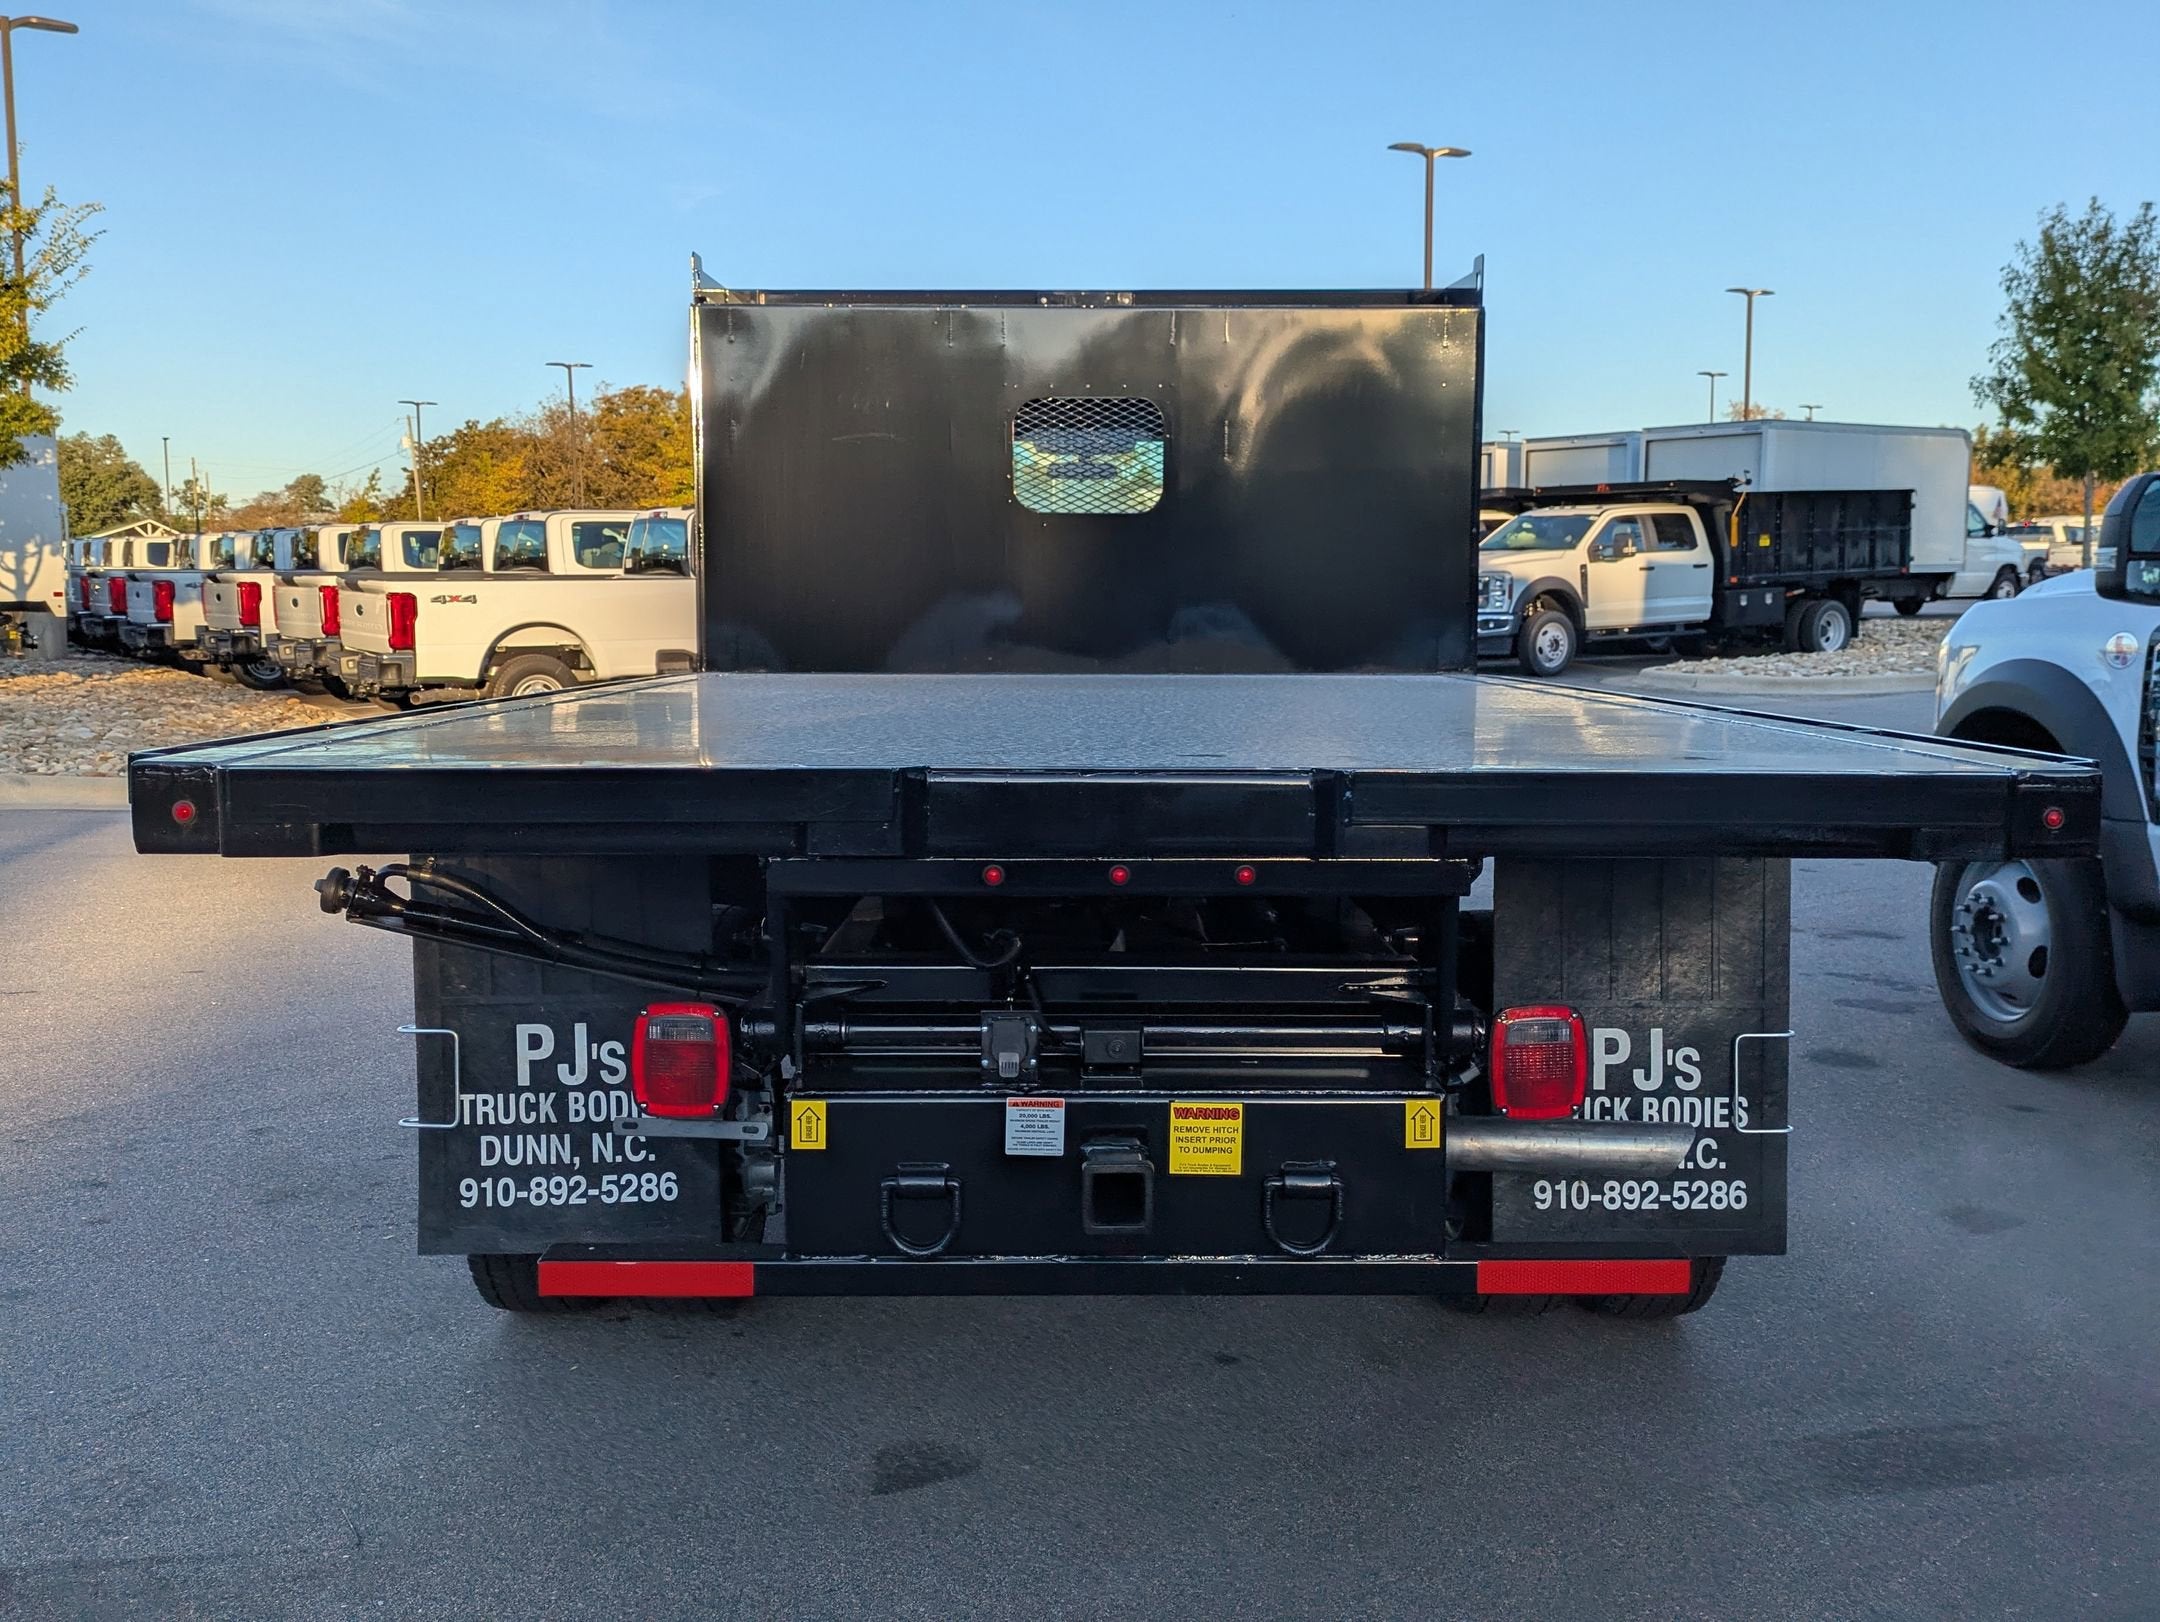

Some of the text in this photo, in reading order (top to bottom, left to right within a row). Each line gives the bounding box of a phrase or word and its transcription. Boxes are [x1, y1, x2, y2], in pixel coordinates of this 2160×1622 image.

[459, 1092, 558, 1125] TRUCK
[1173, 1107, 1241, 1120] WARNING
[1642, 1096, 1749, 1128] BODIES
[480, 1132, 656, 1170] DUNN, N.C.
[459, 1172, 679, 1208] 910-892-5286
[1533, 1180, 1748, 1210] 910-892-5286
